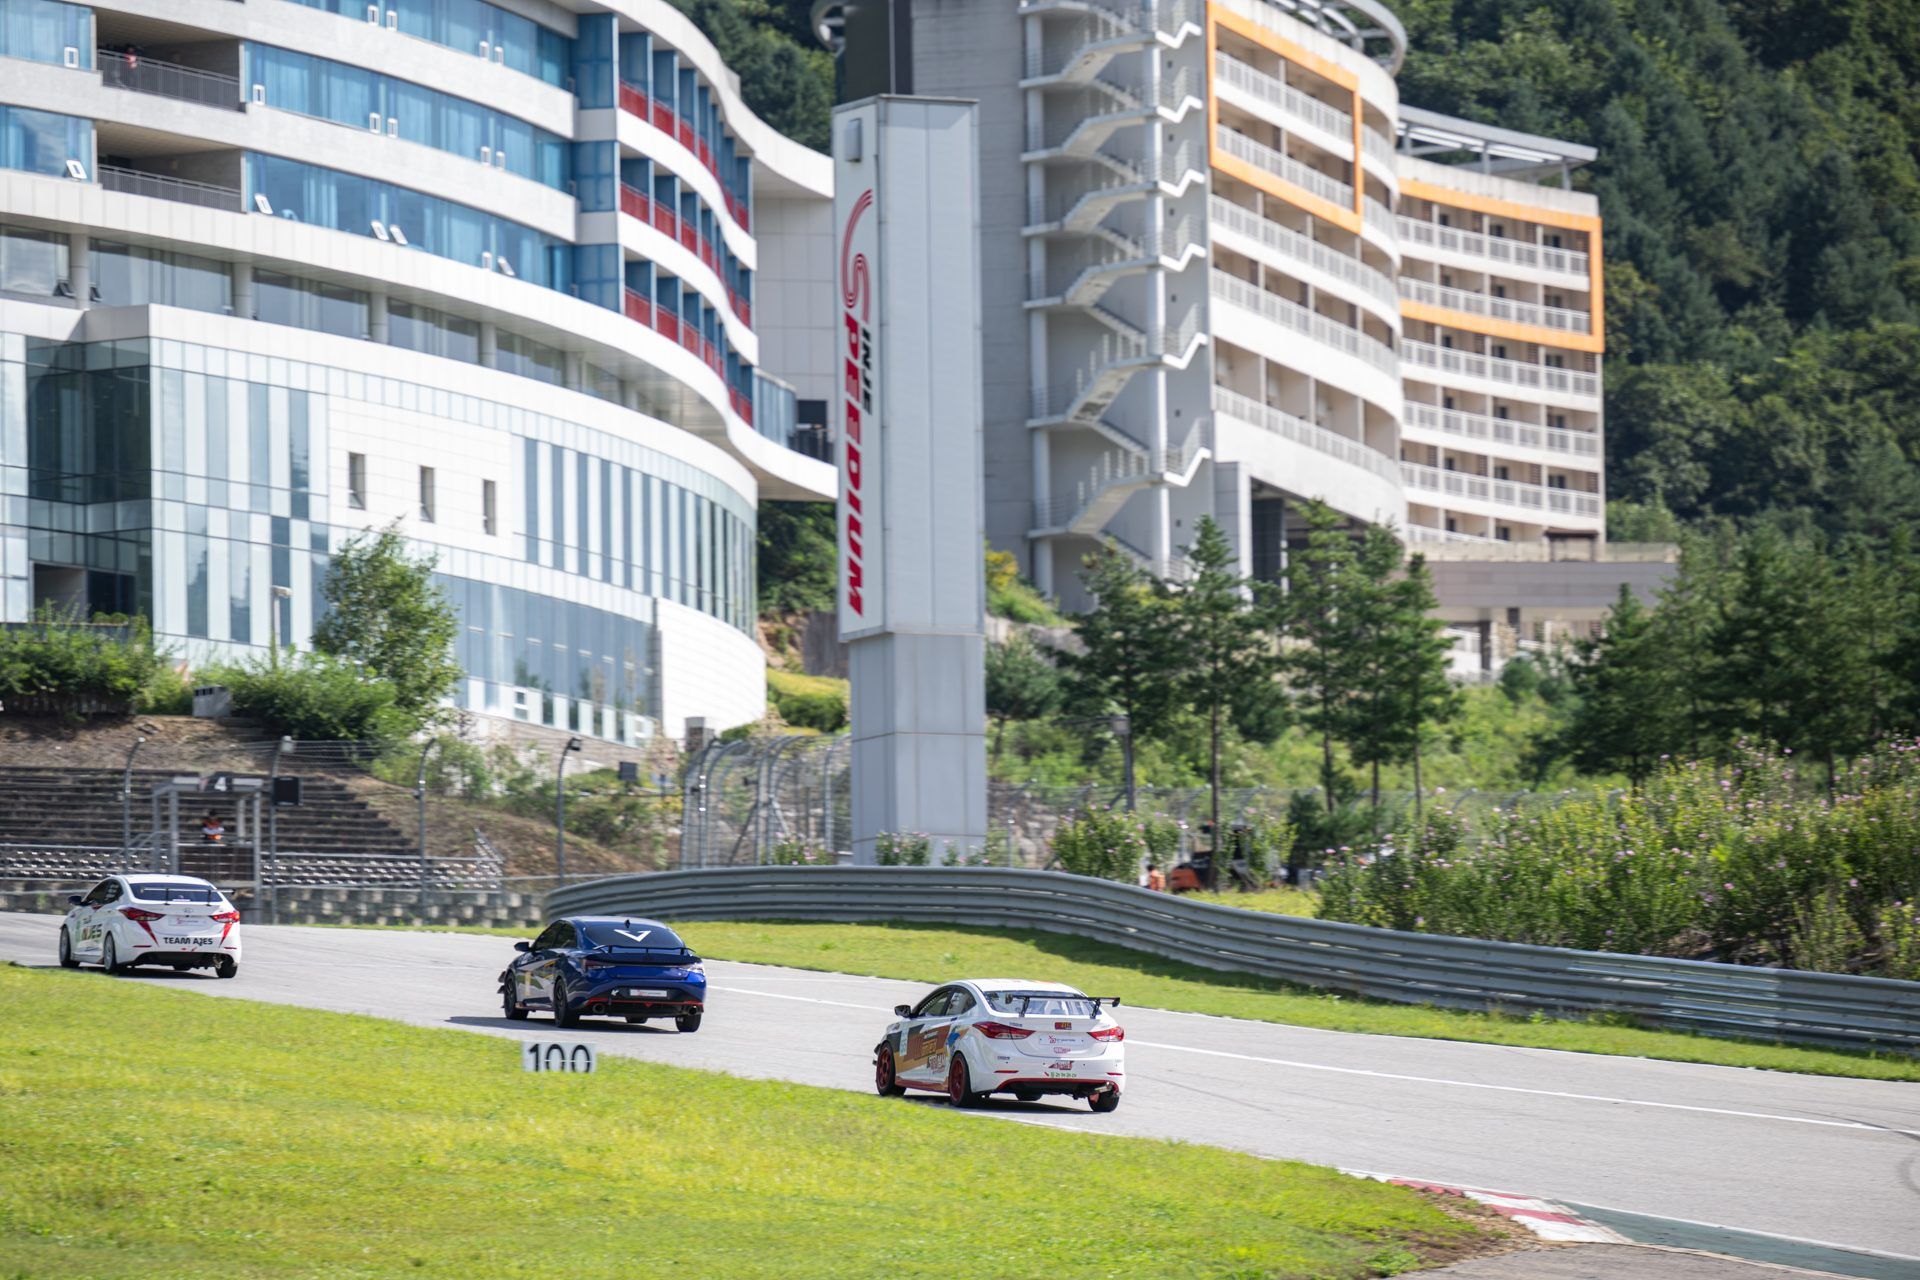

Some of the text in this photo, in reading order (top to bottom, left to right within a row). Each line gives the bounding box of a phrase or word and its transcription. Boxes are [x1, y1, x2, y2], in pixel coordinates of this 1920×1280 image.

[861, 327, 872, 415] INJE
[214, 776, 227, 792] 4
[163, 937, 213, 946] TEAM AJES
[528, 1043, 591, 1073] 100
